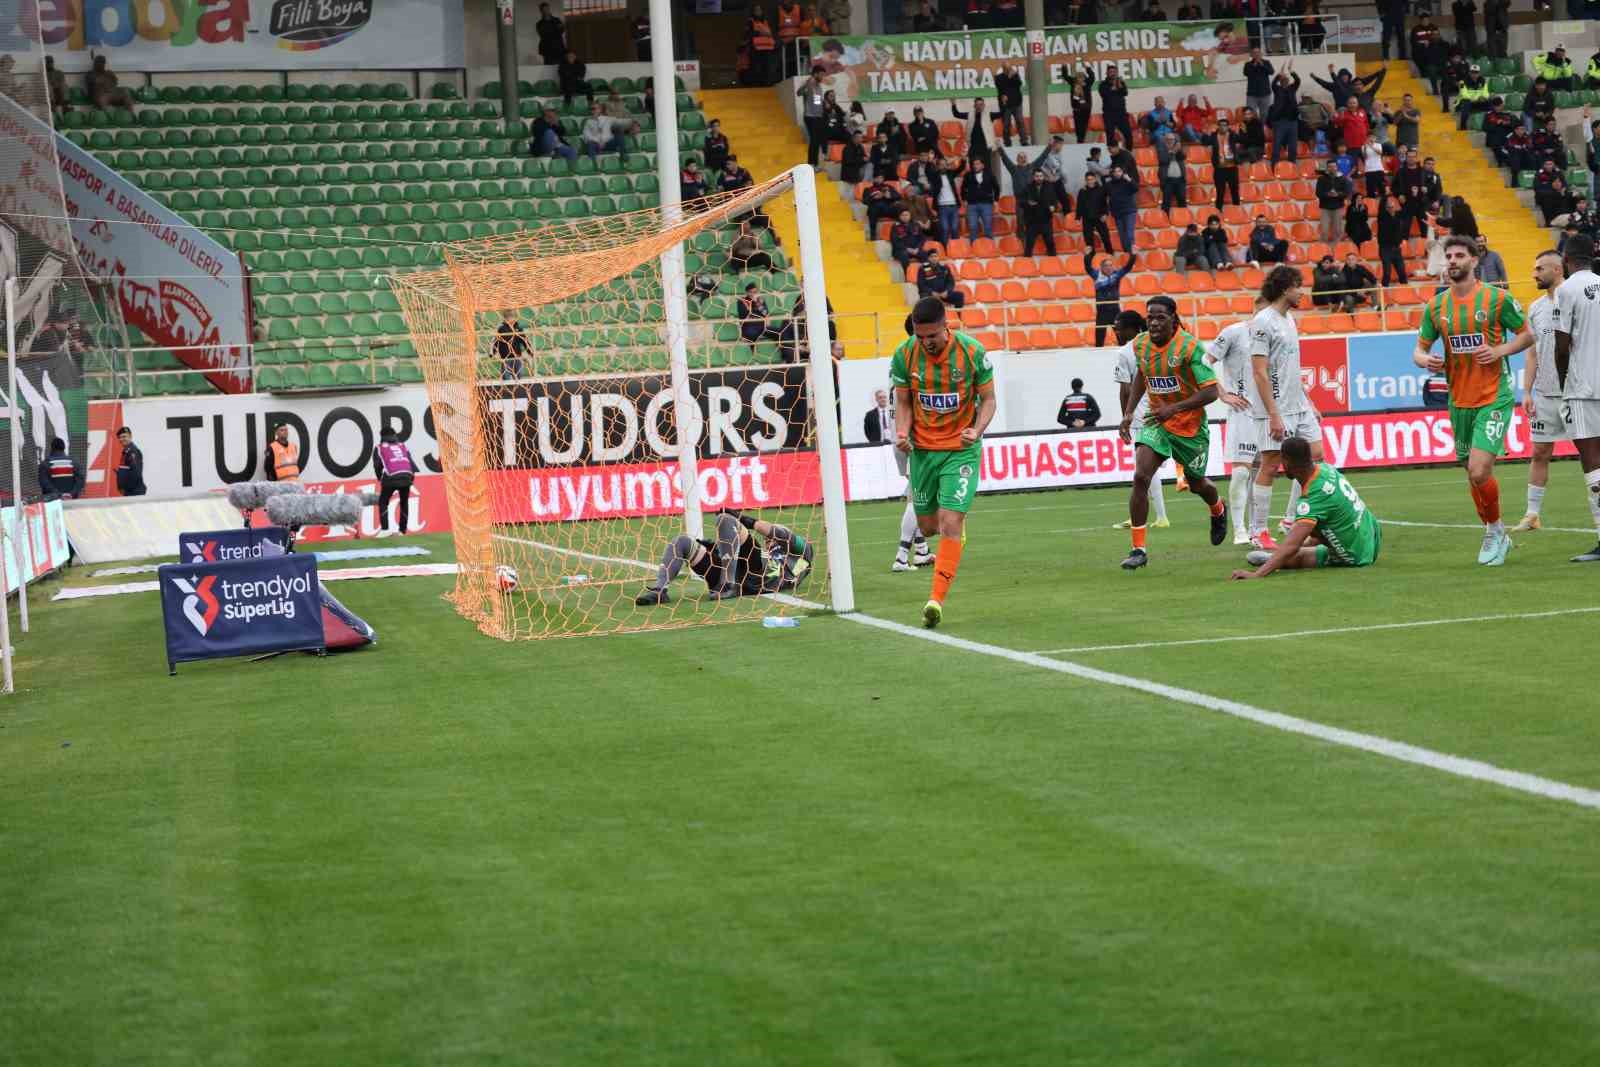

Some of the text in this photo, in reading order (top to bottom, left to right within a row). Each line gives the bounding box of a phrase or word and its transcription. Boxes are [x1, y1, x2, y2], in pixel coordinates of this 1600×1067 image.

[277, 0, 368, 28] Filli Boya
[903, 28, 1171, 62] HAYDİ ALAYAM SENDE
[1031, 42, 1044, 55] B
[867, 70, 929, 93] TAHA
[1153, 56, 1194, 79] TUT
[488, 381, 788, 466] TUDORS
[1485, 421, 1505, 439] 50
[219, 542, 263, 560] trend
[222, 572, 311, 600] trendyol
